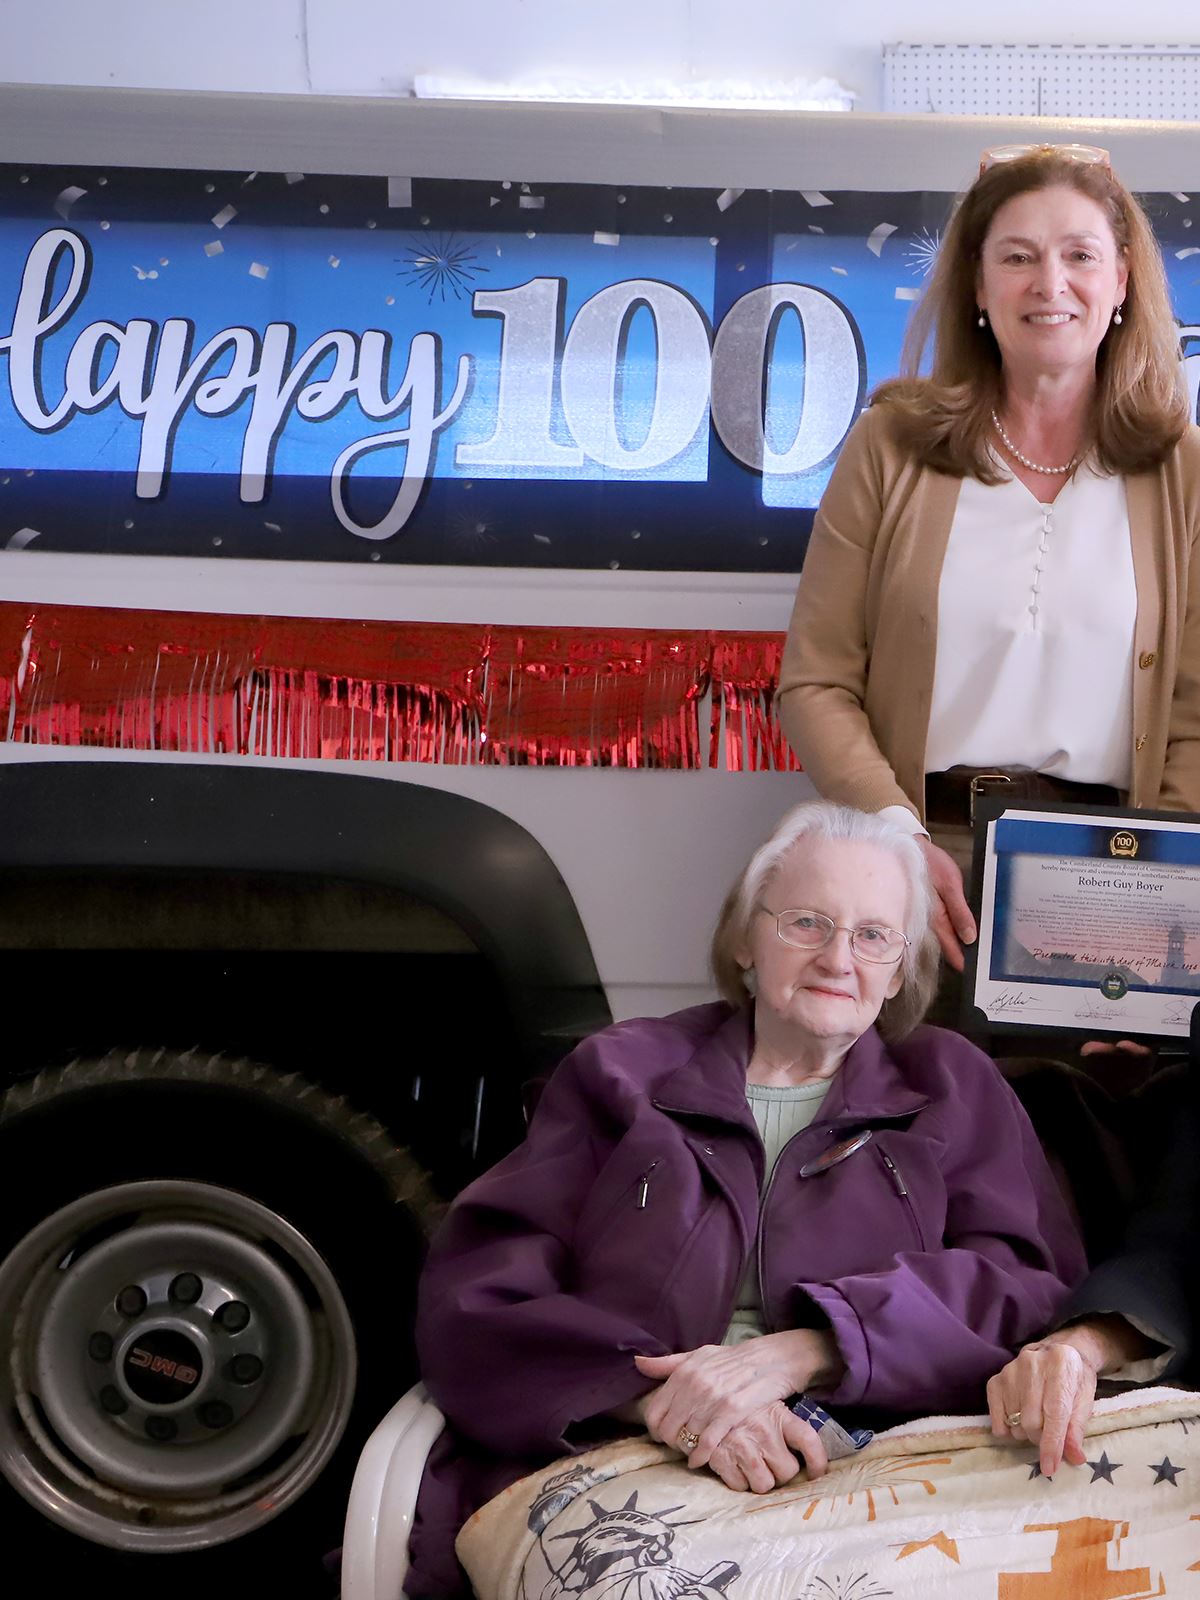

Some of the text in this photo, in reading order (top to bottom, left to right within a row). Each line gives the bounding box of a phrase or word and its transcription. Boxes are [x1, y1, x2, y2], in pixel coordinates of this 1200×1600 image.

[456, 277, 863, 476] 100
[1078, 876, 1164, 893] Robert Guy Boyer
[130, 1348, 197, 1385] GMC
